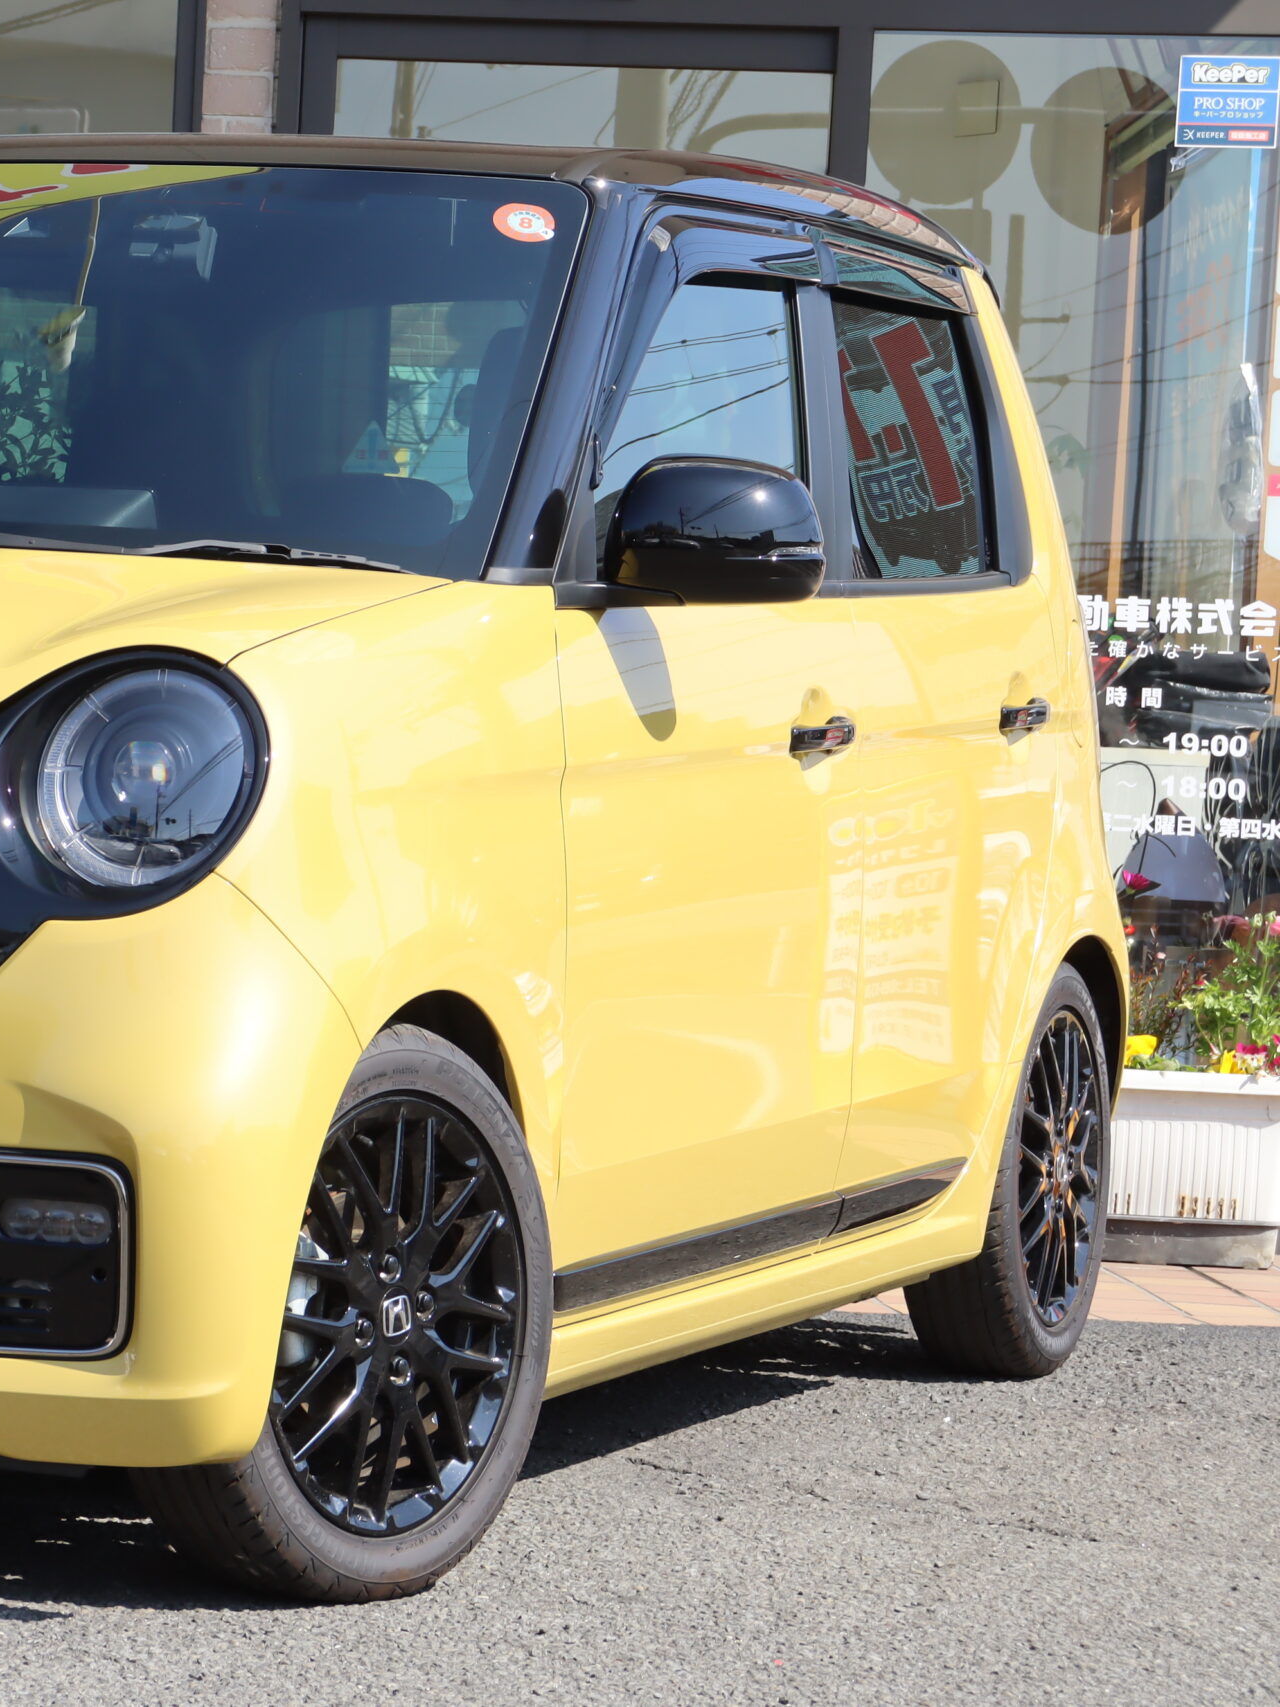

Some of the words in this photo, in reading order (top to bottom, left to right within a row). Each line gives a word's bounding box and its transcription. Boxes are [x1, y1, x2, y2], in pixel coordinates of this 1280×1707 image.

[1192, 63, 1269, 84] KeePer
[1193, 97, 1223, 110] PRO
[1225, 97, 1265, 110] SHOP
[1196, 131, 1225, 139] KEEPER
[1163, 731, 1248, 757] 19:00
[1161, 775, 1247, 801] 18:00
